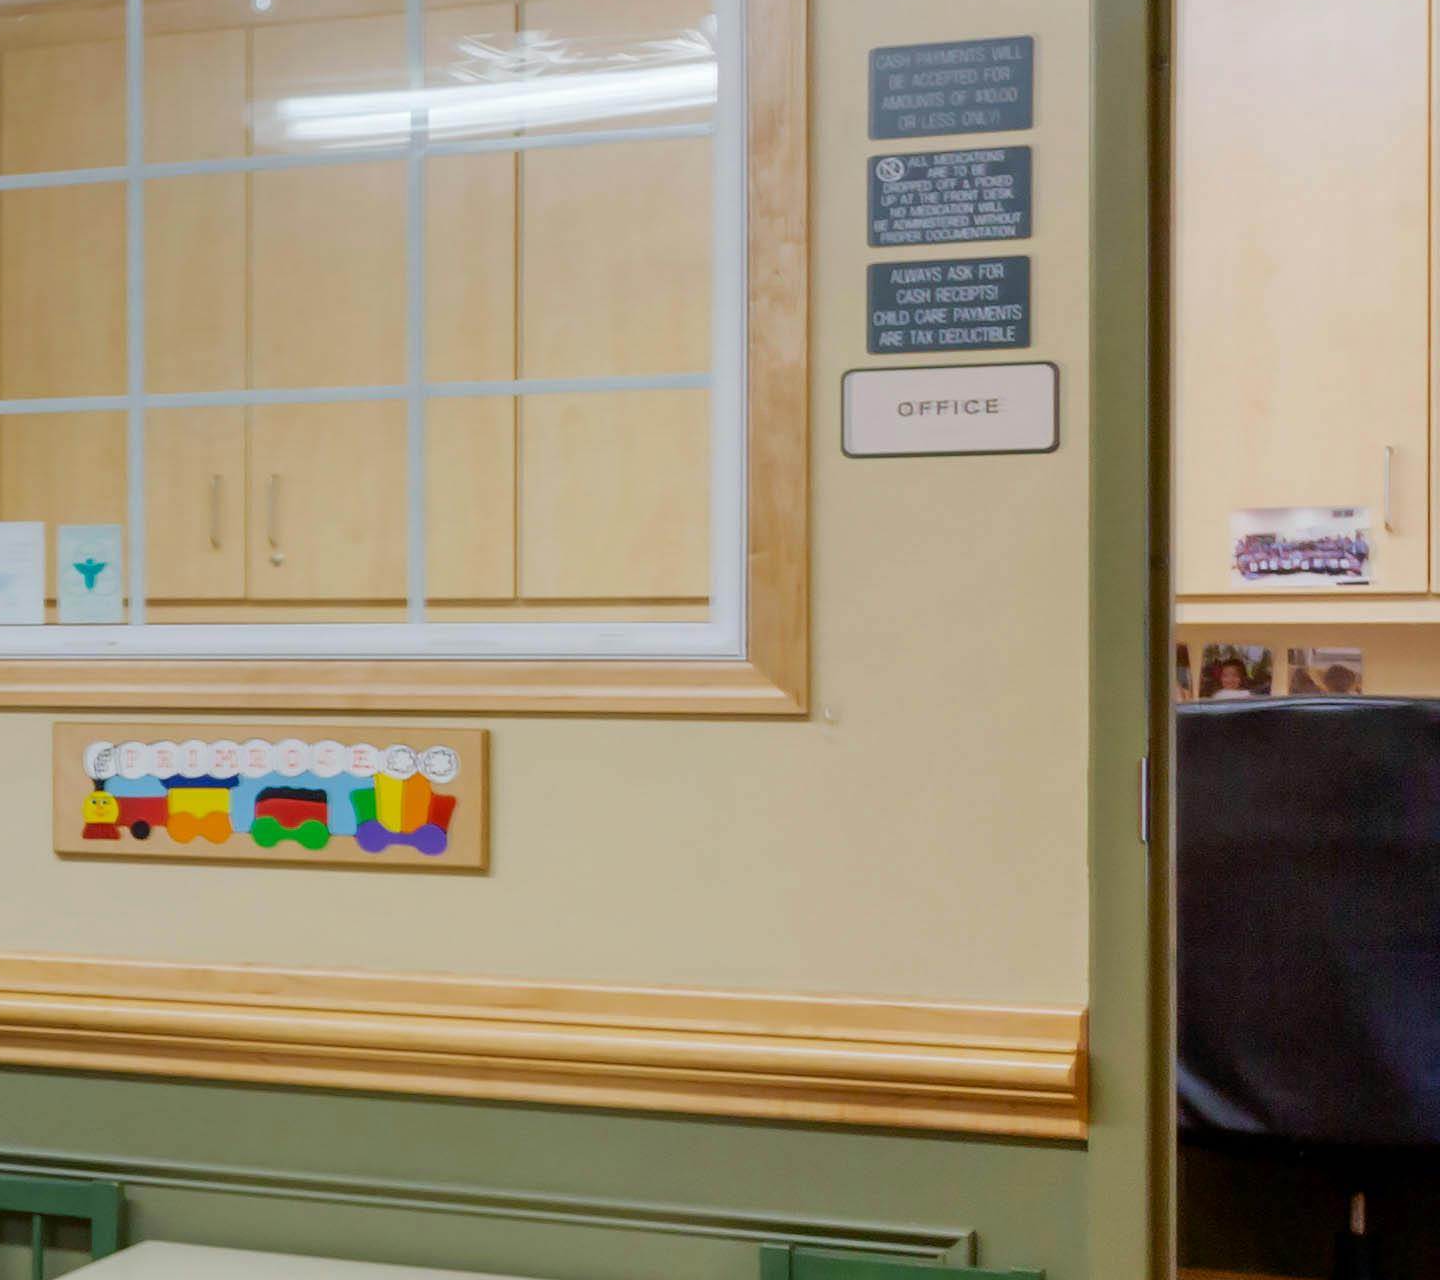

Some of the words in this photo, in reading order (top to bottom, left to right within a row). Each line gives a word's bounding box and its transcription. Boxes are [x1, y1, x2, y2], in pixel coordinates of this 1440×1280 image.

[875, 54, 911, 70] CASH
[914, 47, 985, 66] PAYMENTS
[991, 45, 1023, 61] WILL
[912, 68, 978, 88] ACCEPTED
[984, 65, 1011, 82] FOR
[882, 91, 945, 111] AMOUNTS
[950, 90, 969, 106] OF
[897, 114, 917, 130] OR
[921, 111, 957, 129] LESS
[907, 154, 928, 168] ALL
[933, 150, 1005, 165] MEDICATIONS
[927, 166, 949, 178] ARE
[953, 165, 968, 177] TO
[882, 179, 932, 194] DROPPED
[935, 178, 958, 191] OFF
[974, 174, 1014, 188] PICKED
[880, 193, 897, 207] UP
[899, 192, 914, 205] AT
[919, 191, 940, 204] THE
[943, 189, 979, 203] FRONT
[910, 202, 974, 217] MEDICATION
[977, 201, 1004, 213] WILL
[973, 211, 1023, 226] WITHOUT
[890, 266, 942, 285] ALWAYS
[947, 265, 974, 281] ASK
[978, 263, 1005, 279] FOR
[896, 287, 931, 305] CASH
[872, 310, 910, 327] CHILD
[914, 308, 947, 325] CARE
[953, 304, 1022, 322] PAYMENTS
[878, 330, 904, 347] ARE
[910, 329, 934, 345] TAX
[939, 326, 1016, 344] DEDUCTIBLE
[897, 398, 999, 417] OFFICE
